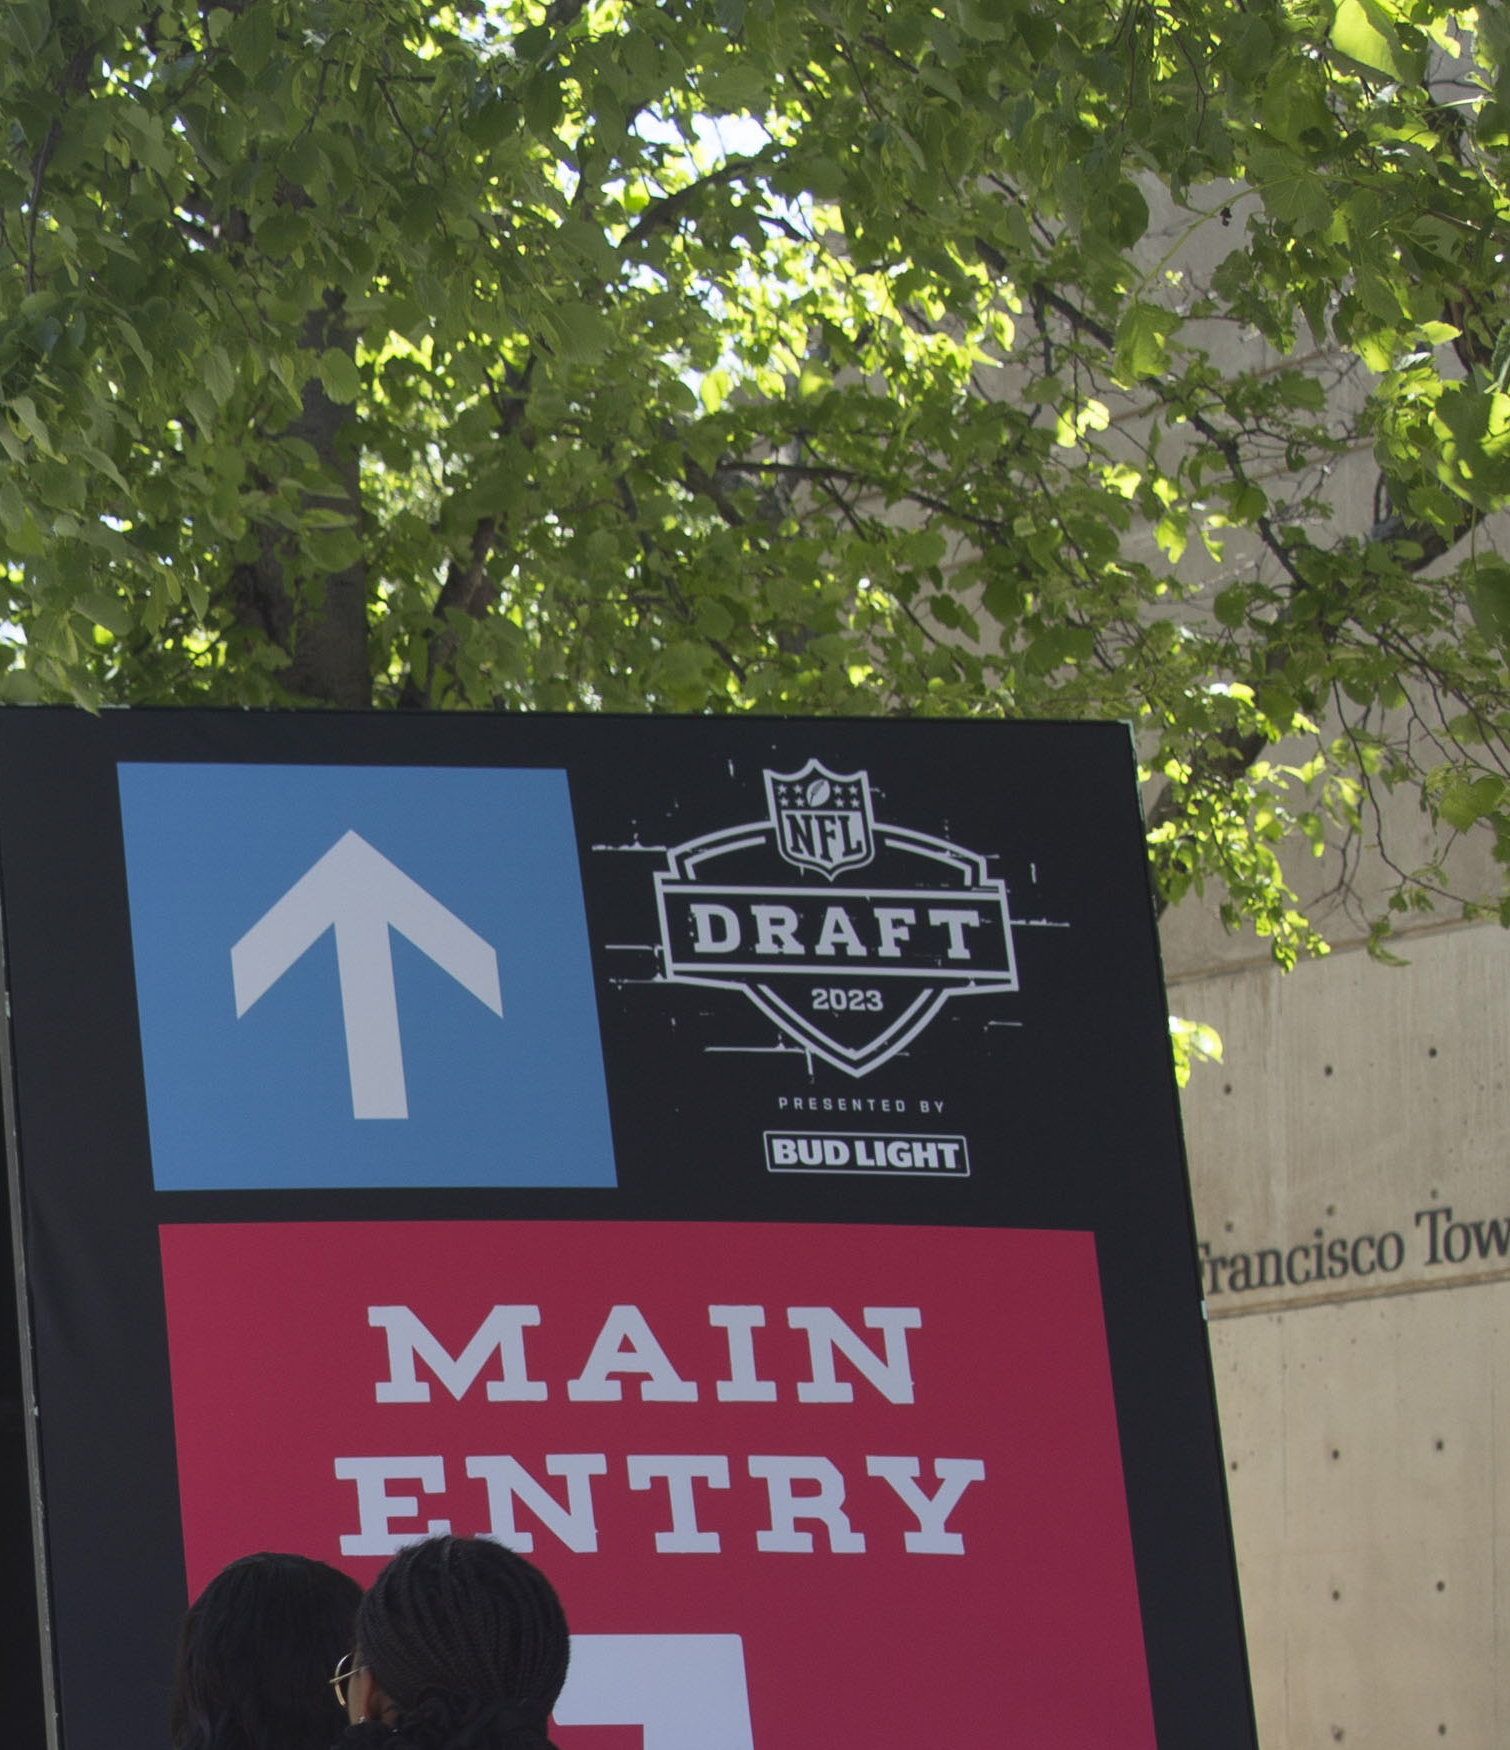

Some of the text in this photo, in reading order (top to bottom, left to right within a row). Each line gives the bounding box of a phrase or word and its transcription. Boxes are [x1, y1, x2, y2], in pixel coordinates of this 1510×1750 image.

[785, 814, 863, 863] NFL
[690, 903, 980, 960] DRAFT
[811, 988, 884, 1012] 2023
[778, 1097, 945, 1114] PRESENTED BY
[771, 1138, 960, 1169] BUD LIGHT
[367, 1304, 922, 1404] MAIN
[334, 1453, 986, 1555] ENTRY
